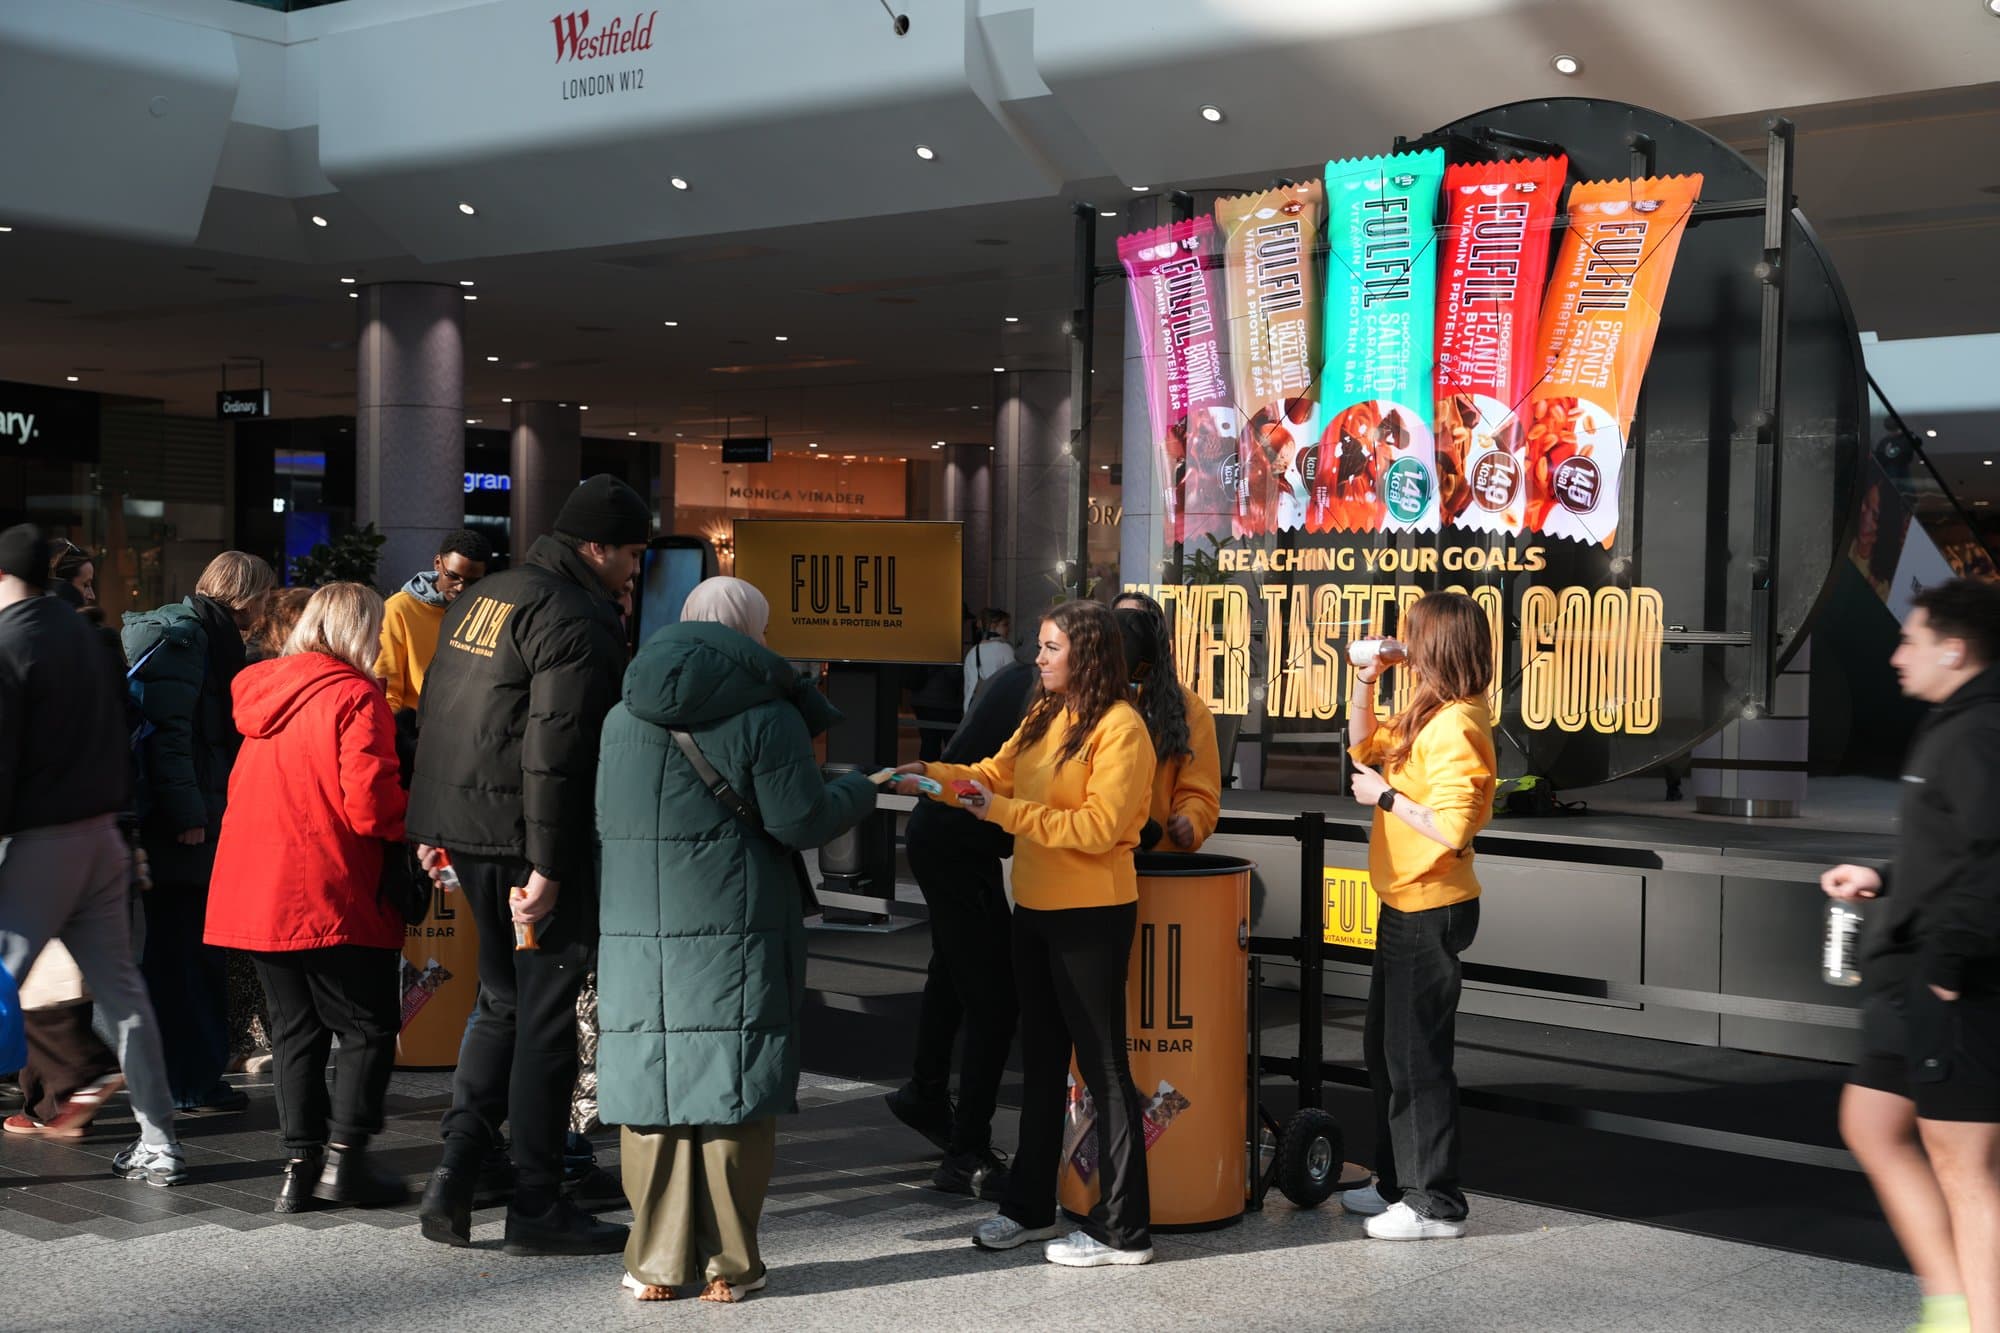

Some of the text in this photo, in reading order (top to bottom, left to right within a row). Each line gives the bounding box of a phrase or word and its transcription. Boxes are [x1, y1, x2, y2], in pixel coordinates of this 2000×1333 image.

[549, 9, 658, 64] Westfield
[563, 68, 644, 100] LONDON W12
[1257, 219, 1304, 322] FULFIL
[1362, 196, 1410, 309] FULFIL
[1462, 202, 1529, 307] FULFIL
[1571, 223, 1598, 277] VITAMIN
[1575, 221, 1648, 315] FULFIL
[1162, 256, 1214, 347] FULFIL
[1245, 229, 1265, 396] VITAMIN & PROTEIN BAR
[1343, 201, 1362, 393] VITAMIN & PROTEIN BAR
[1438, 205, 1475, 385] VITAMIN & PROTEIN BAR
[1549, 294, 1575, 351] PROTEIN
[1151, 265, 1181, 410] VITAMIN & PROTEIN BAR
[1207, 339, 1227, 398] CHOCOLATE
[1268, 324, 1283, 393] WHIP
[1277, 320, 1304, 390] HAZELNUT
[1297, 319, 1312, 388] CHOCOLATE
[1362, 314, 1378, 392] CARAMEL
[1372, 312, 1402, 392] SALTED
[1396, 312, 1411, 391] CHOCOLATE
[1459, 312, 1478, 386] BUTTER
[1473, 312, 1503, 388] PEANUT
[1496, 313, 1513, 388] CHOCOLATE
[1543, 356, 1557, 383] BAR
[1559, 320, 1588, 385] CARAMEL
[1578, 320, 1613, 388] PEANUT
[1595, 321, 1624, 389] CHOCOLATE
[1183, 341, 1217, 406] BROWNIE
[730, 487, 865, 505] MONICA VINADER
[1306, 456, 1318, 480] kcal
[1389, 471, 1403, 505] kcal
[1475, 462, 1493, 493] kcal
[1484, 463, 1514, 506] 149
[1557, 464, 1574, 491] kcal
[791, 554, 903, 615] FULFIL
[1218, 546, 1546, 574] REACHING YOUR GOALS
[791, 617, 903, 628] VITAMIN & PROTEIN BAR
[1521, 585, 1664, 734] GOOD
[426, 926, 455, 937] BAR
[1324, 934, 1355, 944] VITAMIN
[1157, 1039, 1193, 1053] BAR
